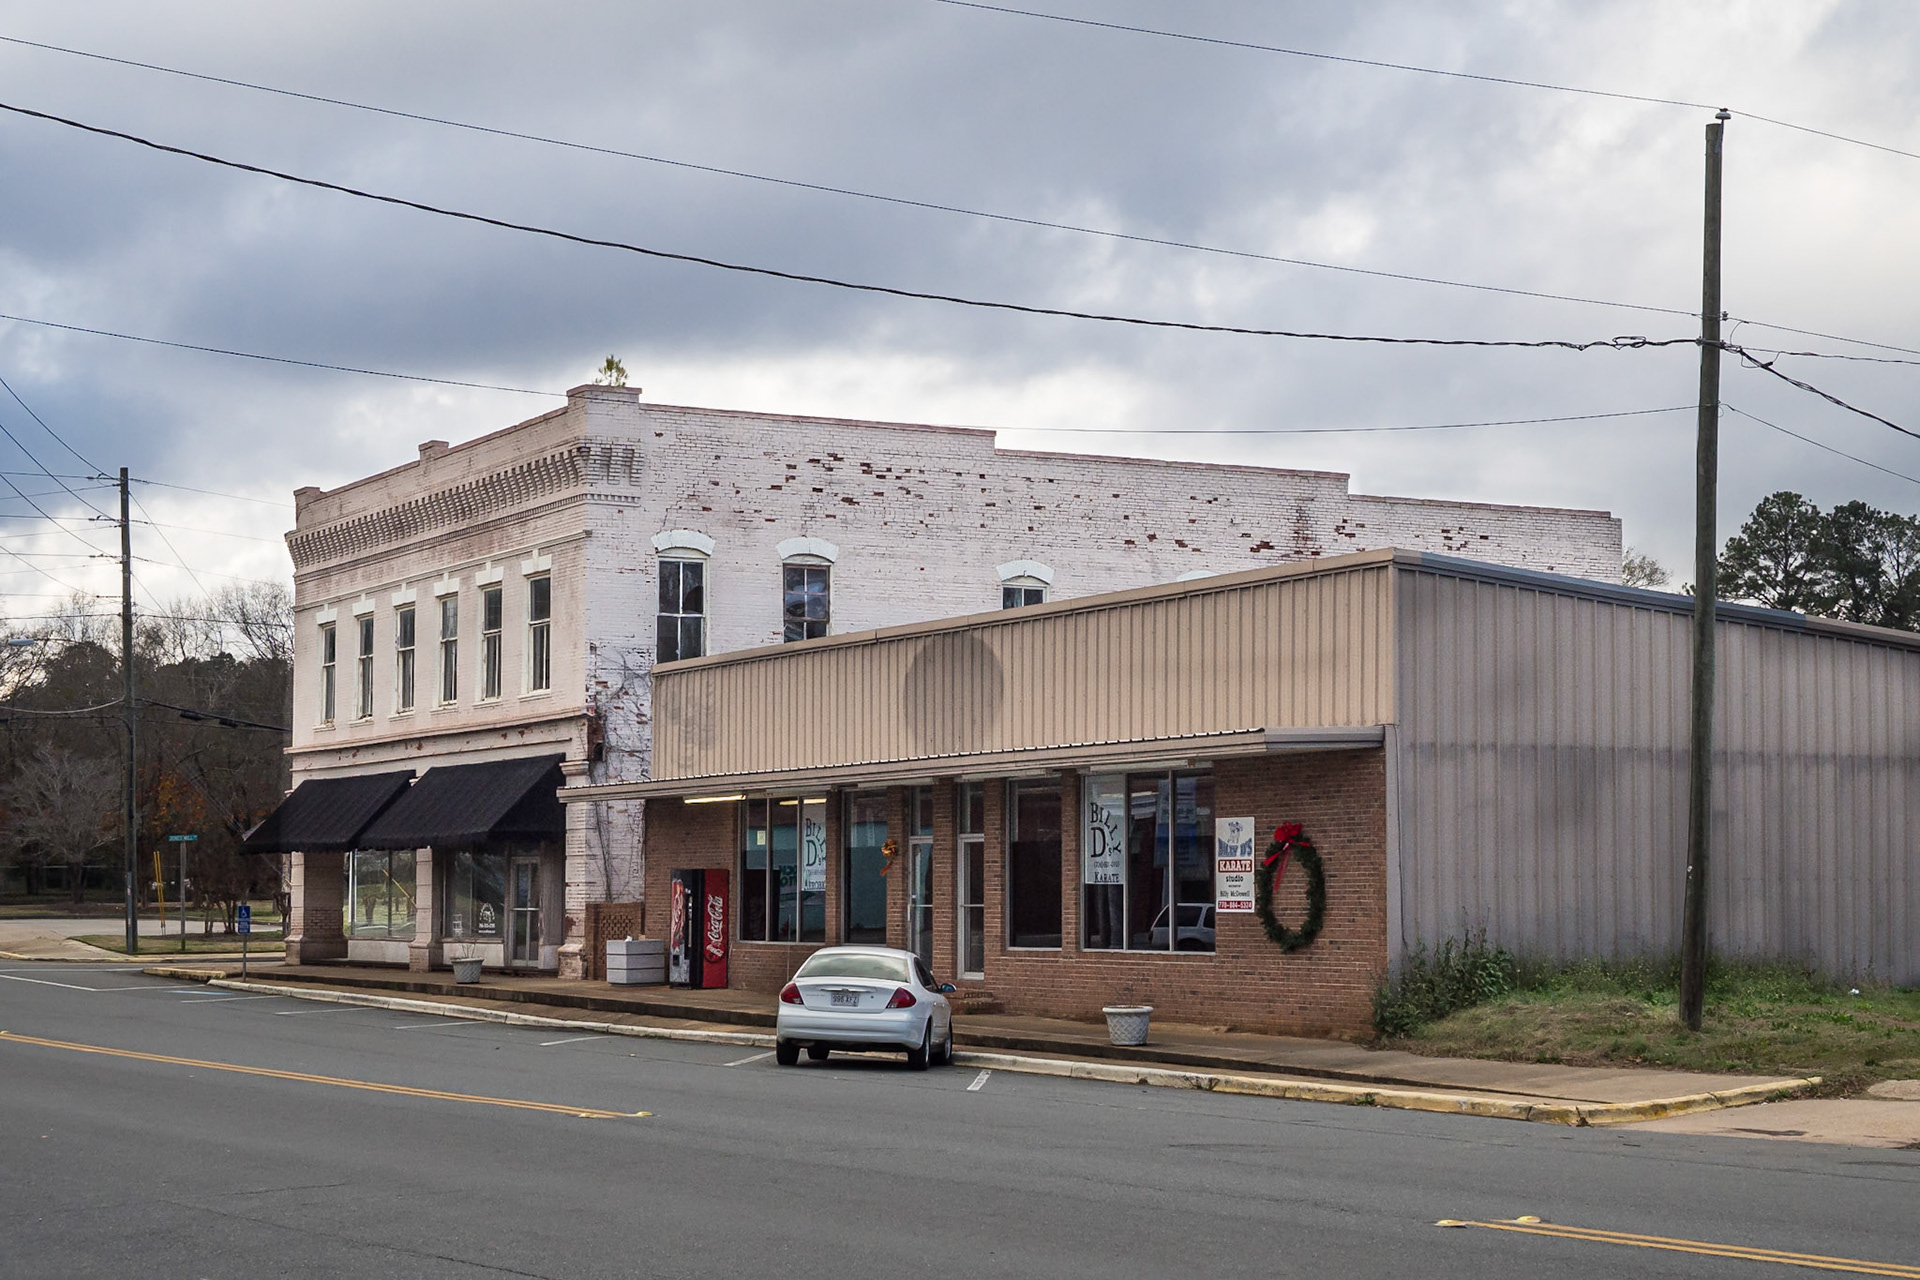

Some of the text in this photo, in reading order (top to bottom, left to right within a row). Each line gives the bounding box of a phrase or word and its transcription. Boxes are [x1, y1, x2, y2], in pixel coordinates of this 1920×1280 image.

[1090, 802, 1122, 855] BILLY
[1219, 860, 1252, 872] KARATE
[1094, 872, 1120, 884] KARATE
[1225, 874, 1244, 883] studio
